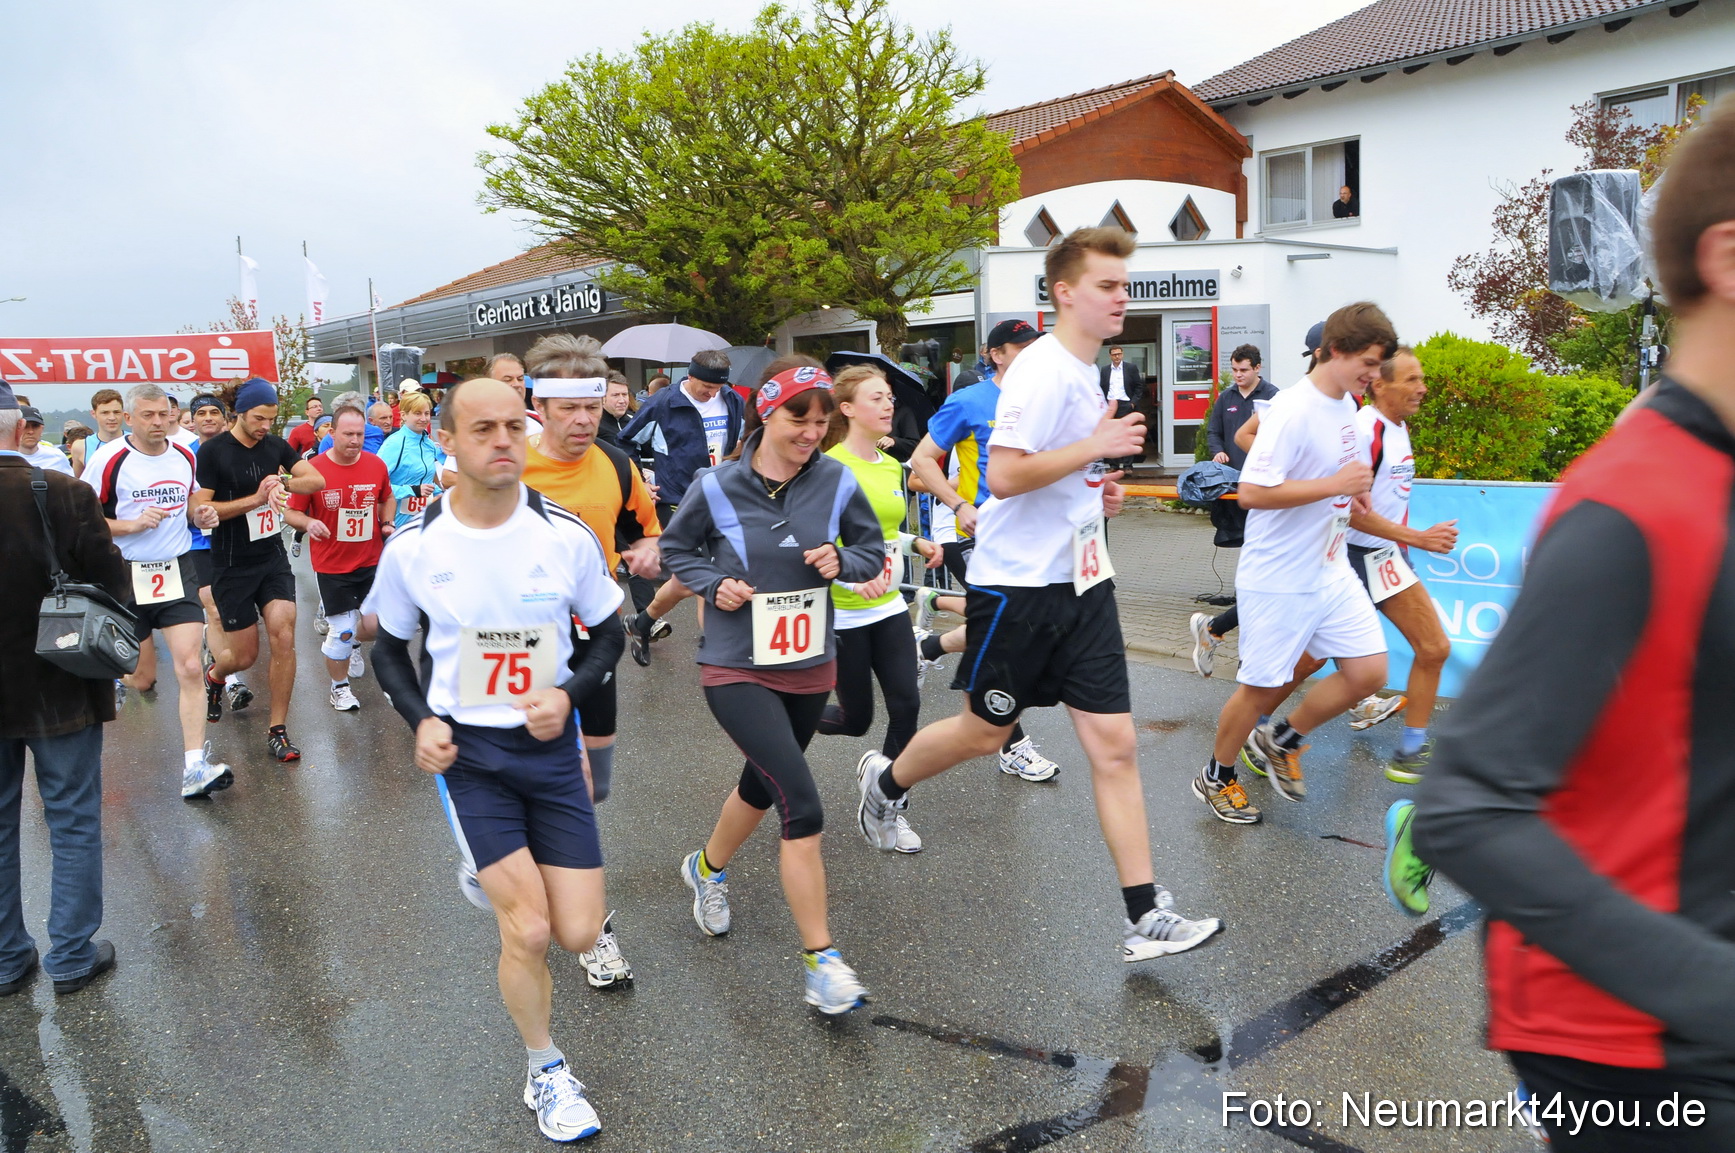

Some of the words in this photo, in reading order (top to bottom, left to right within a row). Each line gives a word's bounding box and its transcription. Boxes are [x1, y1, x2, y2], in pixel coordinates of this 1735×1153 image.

[476, 297, 535, 326] Gerhart
[540, 294, 550, 316] &
[555, 284, 601, 314] Jänig
[703, 419, 727, 428] DTLER
[132, 487, 180, 498] GERHART
[407, 496, 427, 512] 69
[257, 510, 274, 534] 73
[346, 518, 364, 538] 31
[1081, 539, 1099, 581] 43
[1427, 543, 1500, 580] SO
[151, 574, 165, 598] 2
[1378, 559, 1402, 590] 18
[767, 594, 801, 605] MEYER
[476, 631, 522, 641] MEYER
[769, 613, 811, 656] 40
[482, 652, 532, 696] 75
